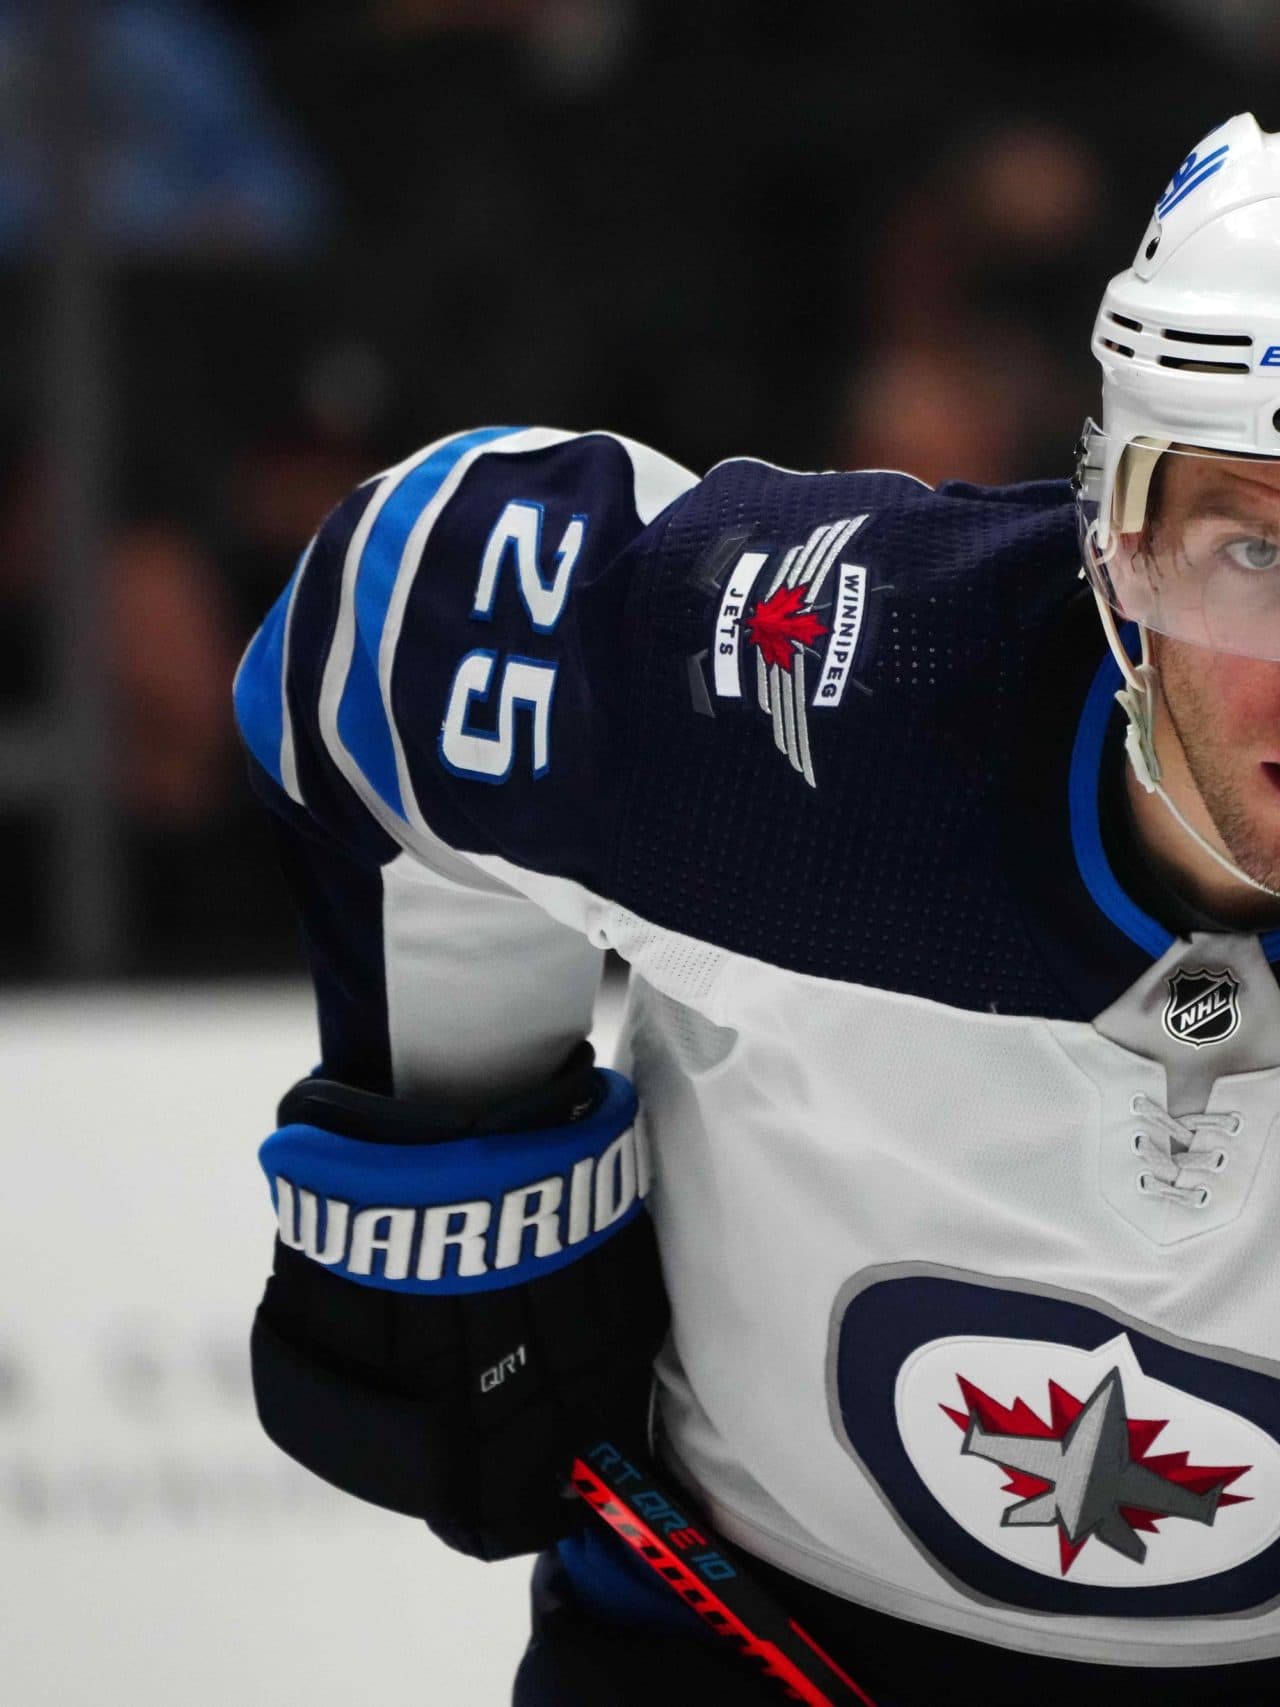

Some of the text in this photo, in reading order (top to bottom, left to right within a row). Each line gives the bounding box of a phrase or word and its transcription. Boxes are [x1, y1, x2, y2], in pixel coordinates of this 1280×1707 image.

[438, 500, 588, 786] 25
[719, 587, 745, 656] JETS
[820, 573, 861, 699] WINNIPEG
[1179, 990, 1227, 1031] NHL
[480, 1345, 526, 1393] QR1
